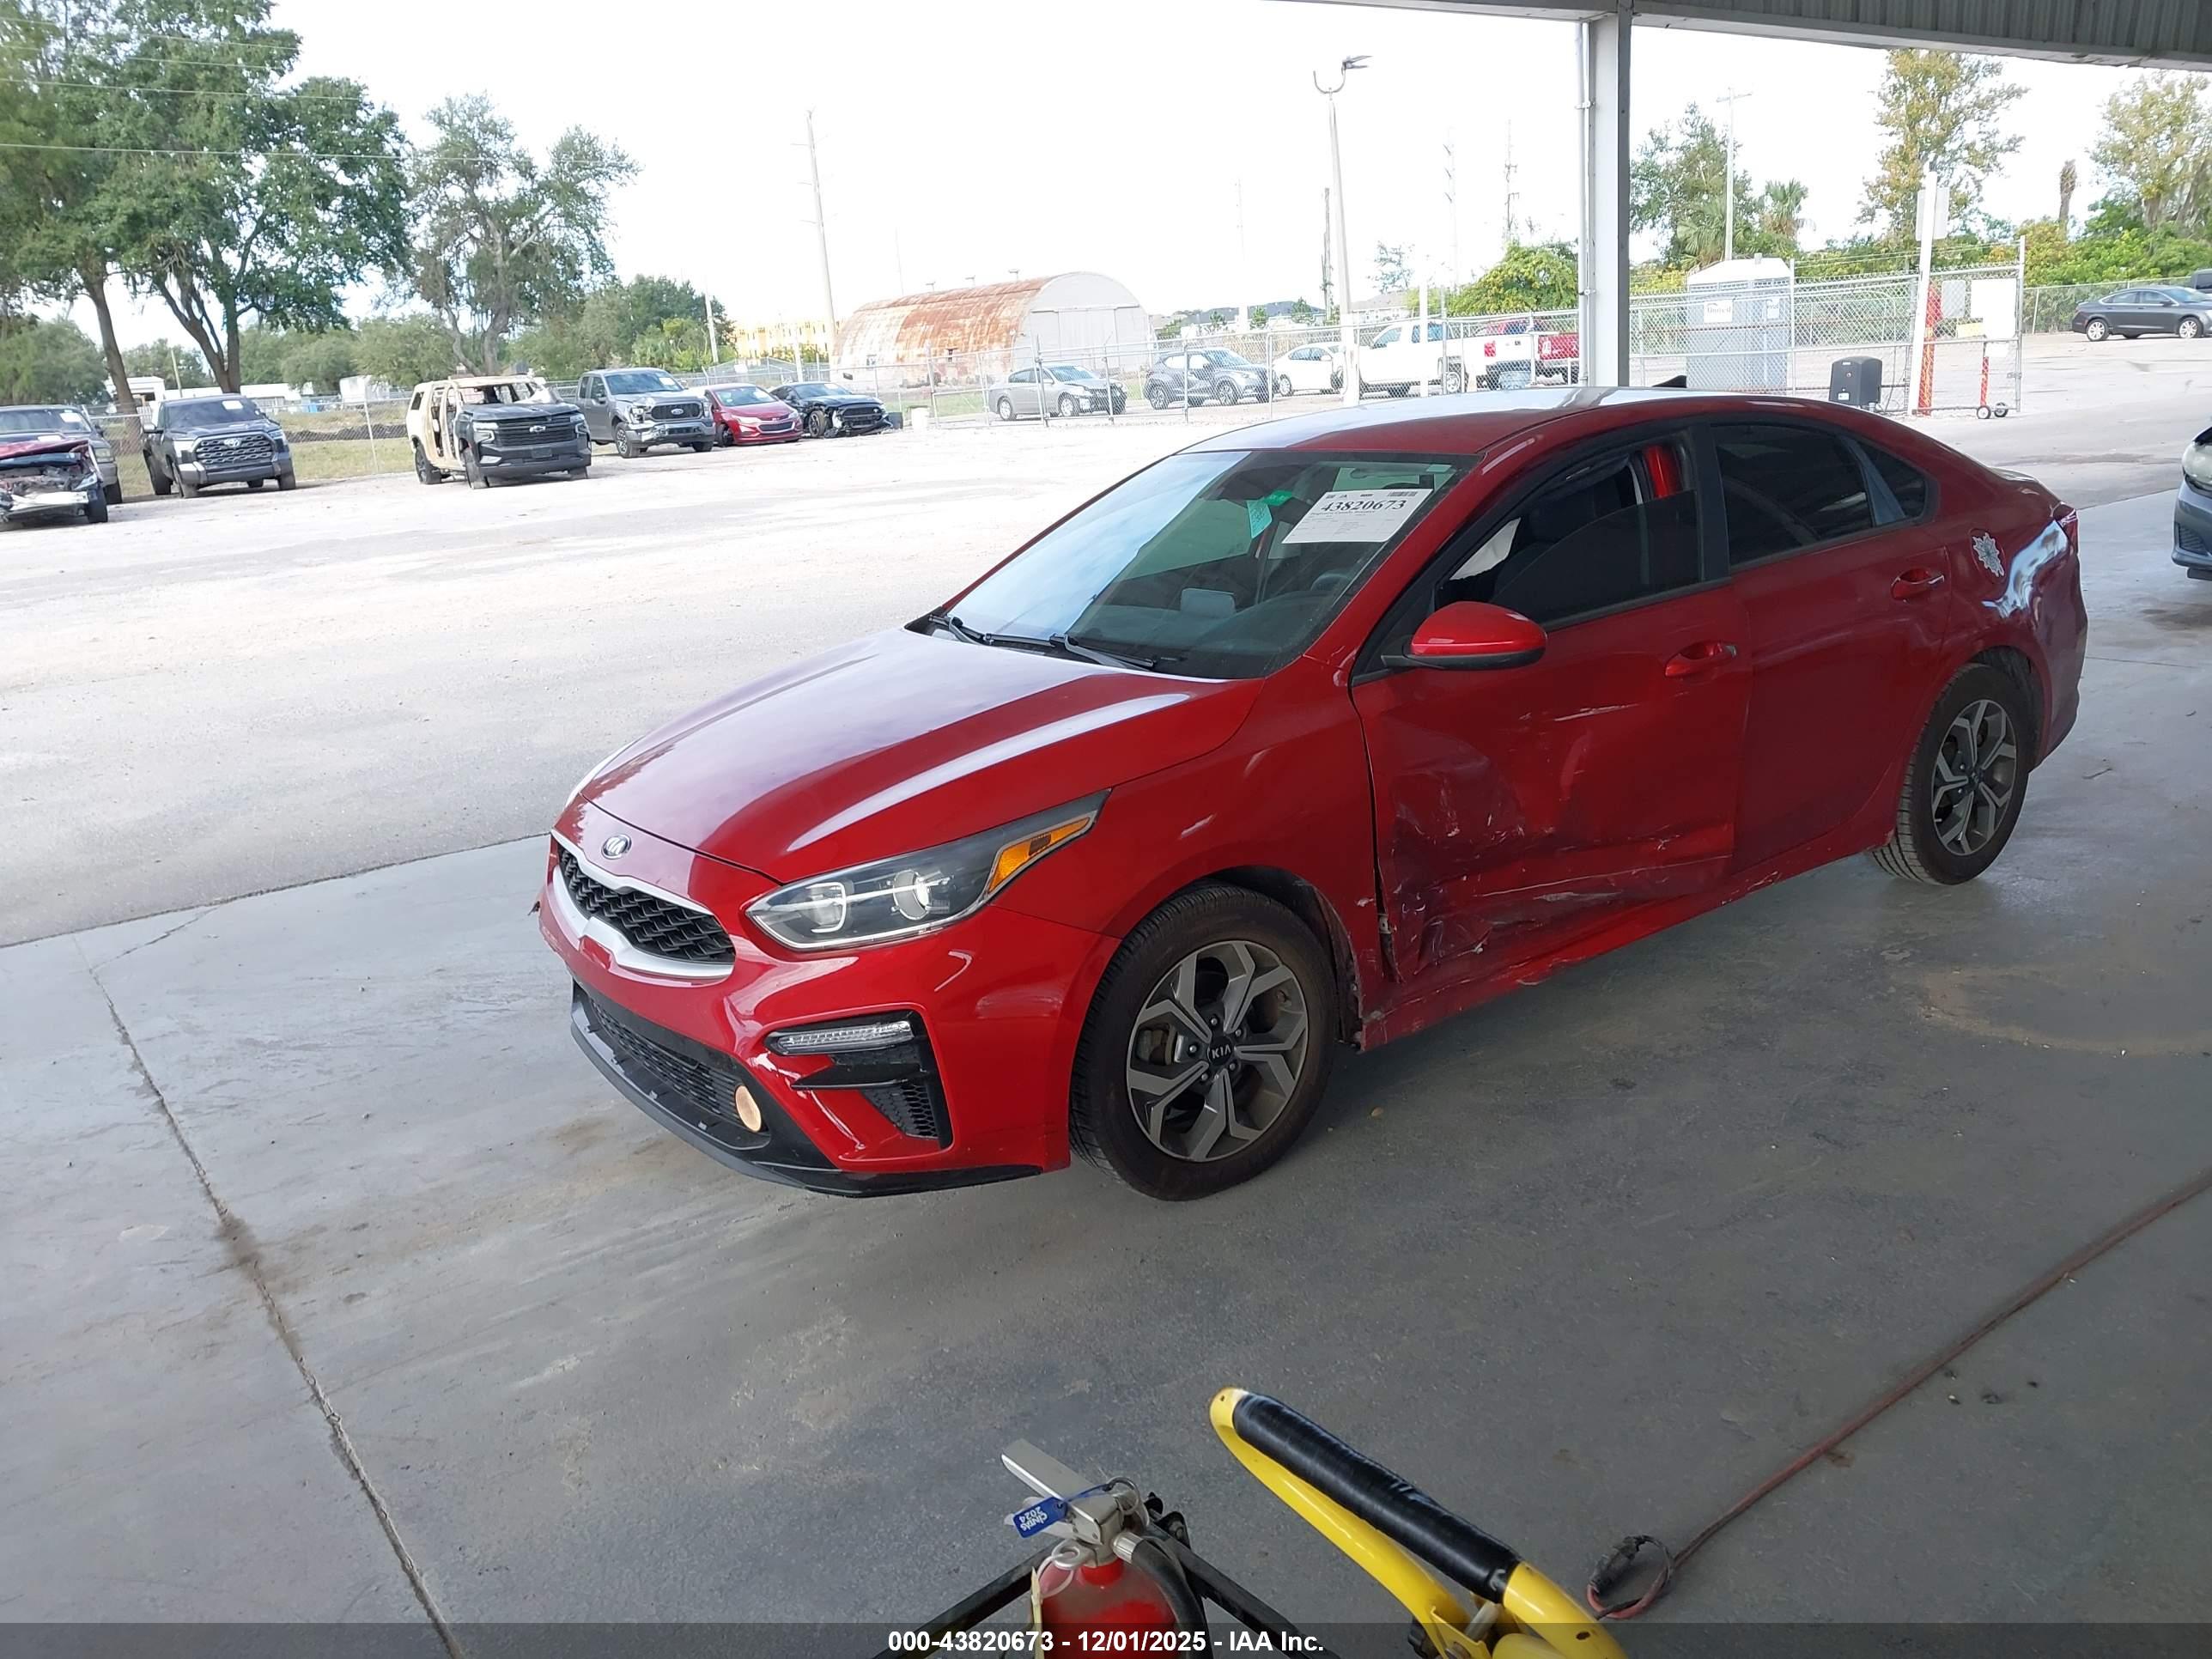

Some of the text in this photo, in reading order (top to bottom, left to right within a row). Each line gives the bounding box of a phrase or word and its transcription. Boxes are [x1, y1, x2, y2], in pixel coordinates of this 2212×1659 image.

[1321, 500, 1407, 512] 43820673
[1211, 1044, 1231, 1059] KIA
[1018, 1506, 1042, 1523] 2024
